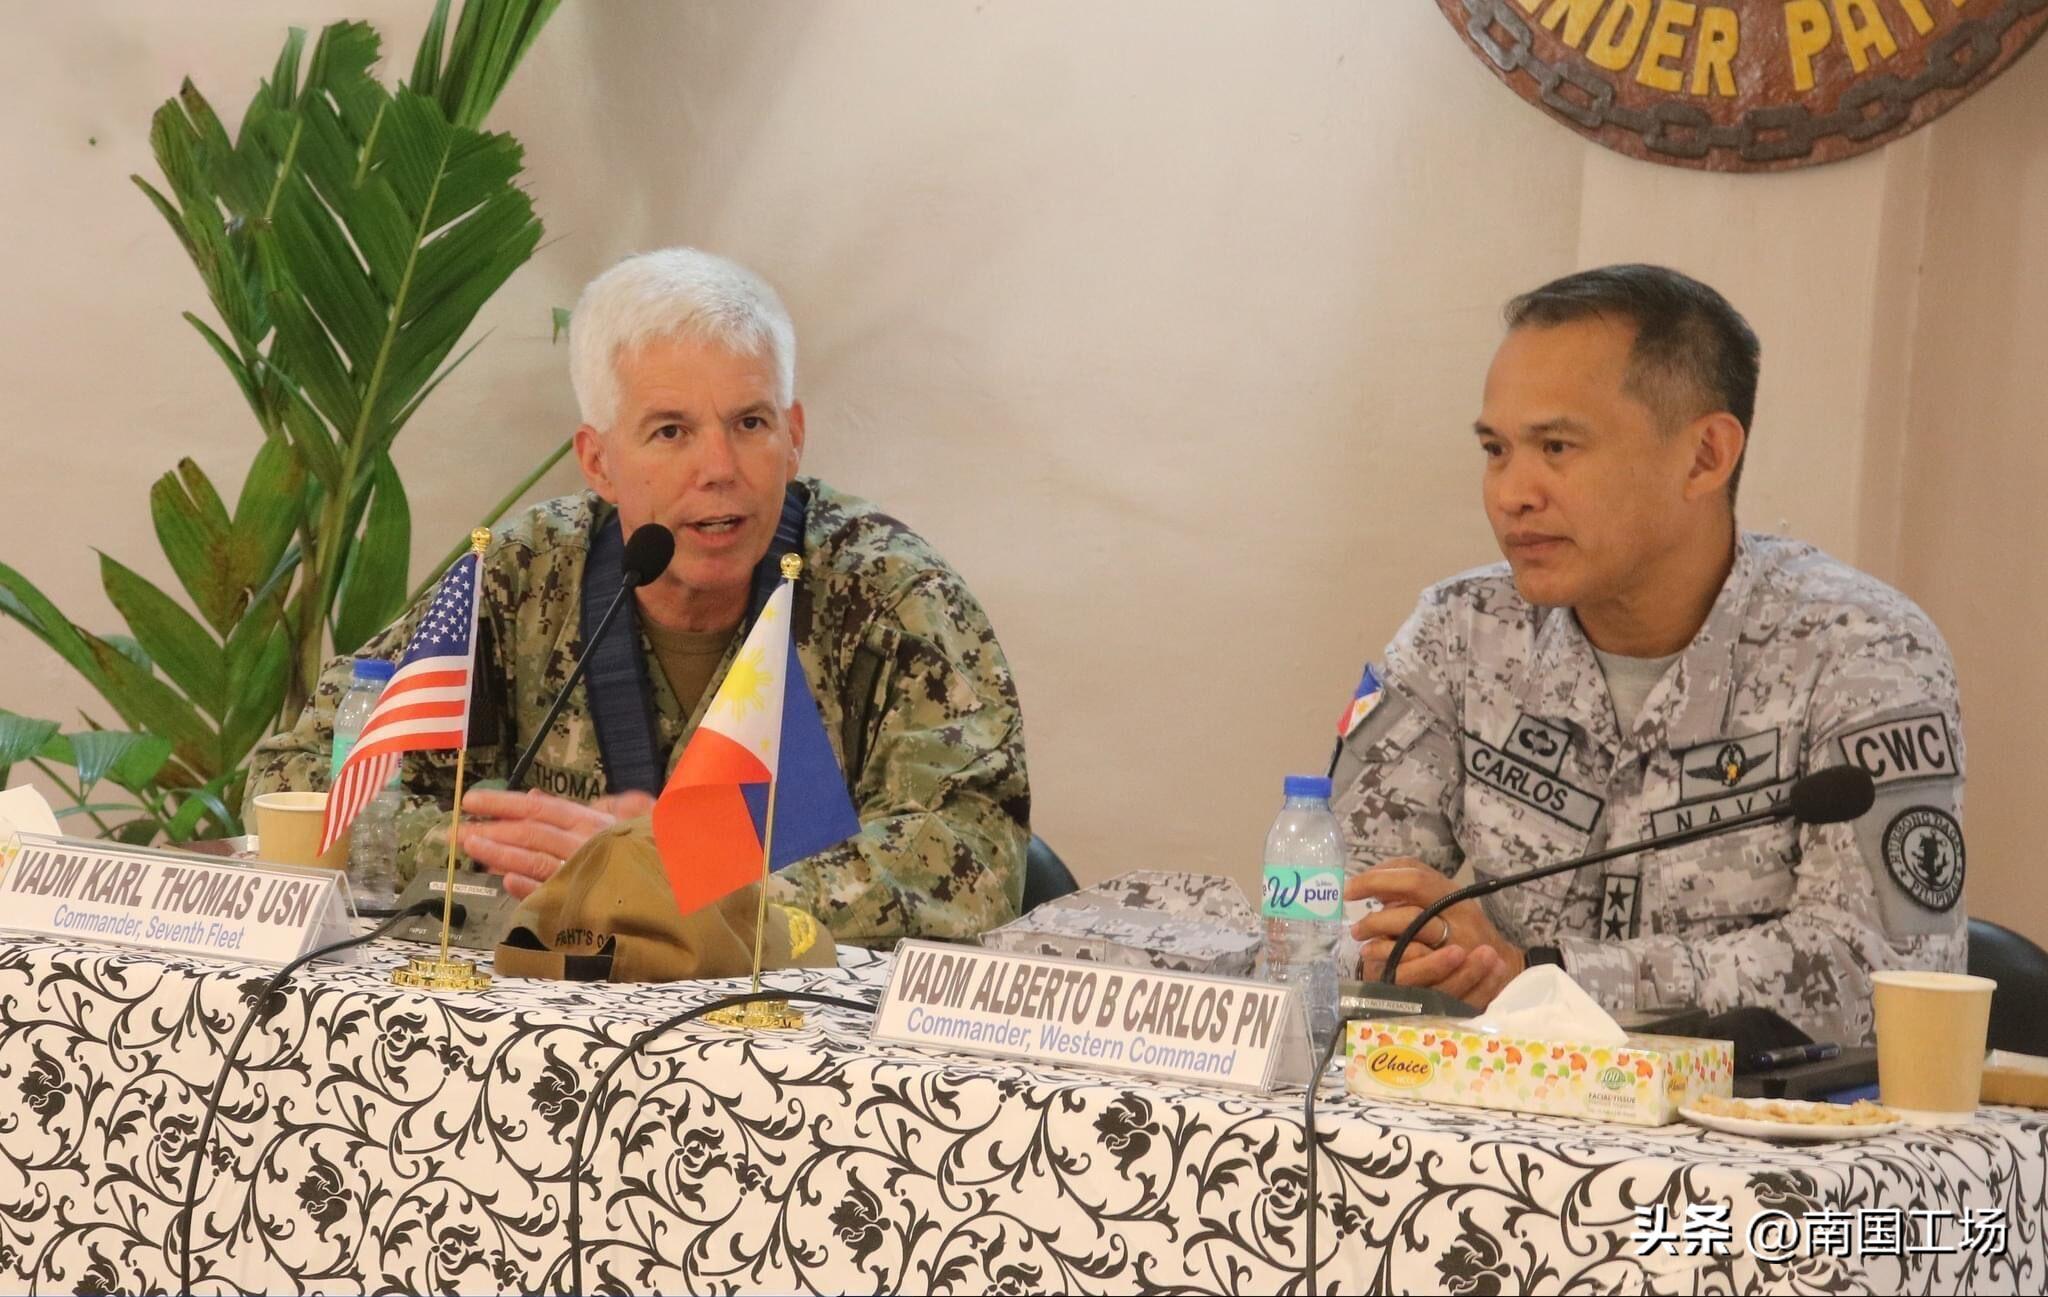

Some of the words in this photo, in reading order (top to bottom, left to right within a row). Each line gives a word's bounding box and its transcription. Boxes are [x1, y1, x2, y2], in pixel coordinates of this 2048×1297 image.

[1517, 0, 1739, 96] NDER
[1855, 724, 1945, 777] CWC
[534, 762, 600, 801] THOMA
[1471, 748, 1568, 812] CARLOS
[11, 849, 84, 899] VADM
[79, 858, 151, 907] KARL
[152, 867, 261, 920] THOMAS
[257, 879, 319, 928] USN
[1304, 888, 1339, 903] pure
[53, 903, 142, 942] Commander,
[145, 915, 206, 945] Seventh
[205, 923, 245, 950] Fleet
[898, 950, 976, 1008] VADM
[971, 960, 1097, 1025] ALBERTO
[1096, 975, 1123, 1028] B
[1123, 978, 1234, 1043] CARLOS
[1232, 992, 1279, 1049] PN
[907, 1006, 1030, 1053] Commander,
[1039, 1024, 1124, 1060] Western
[1129, 1037, 1236, 1075] Command
[1371, 1051, 1428, 1074] Choice
